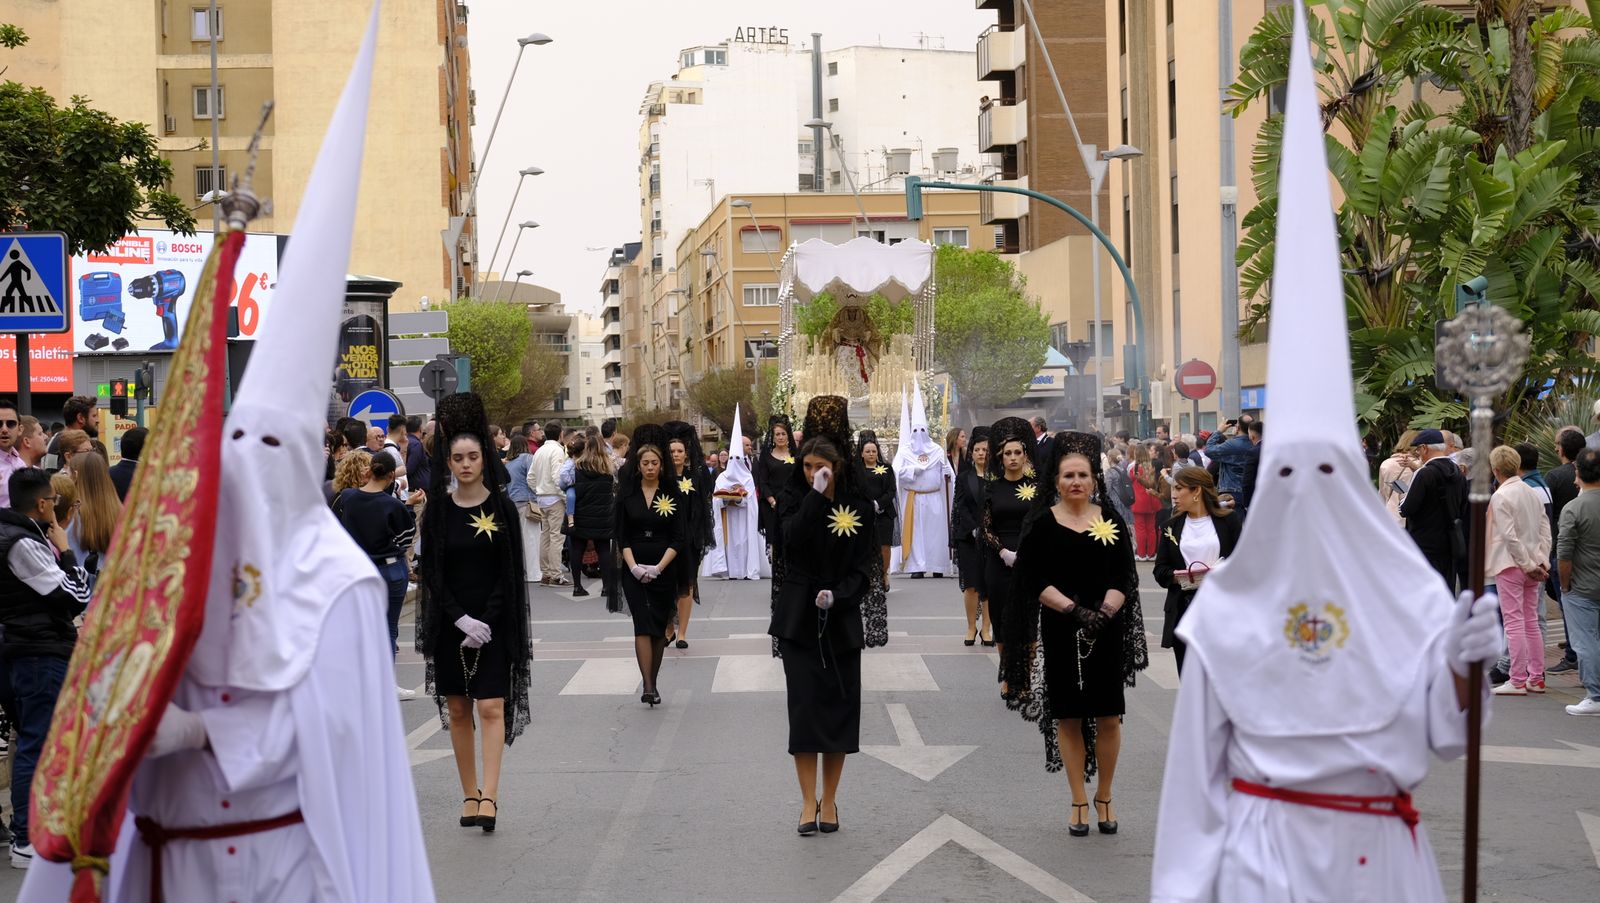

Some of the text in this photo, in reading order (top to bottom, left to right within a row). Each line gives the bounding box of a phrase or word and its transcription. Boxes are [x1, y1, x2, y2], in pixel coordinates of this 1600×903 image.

[735, 26, 788, 44] ARTÉS
[171, 244, 203, 253] BOSCH
[349, 345, 376, 355] NOS
[341, 354, 379, 362] VEMOS
[352, 361, 379, 369] OTRA
[346, 368, 378, 378] VIDA
